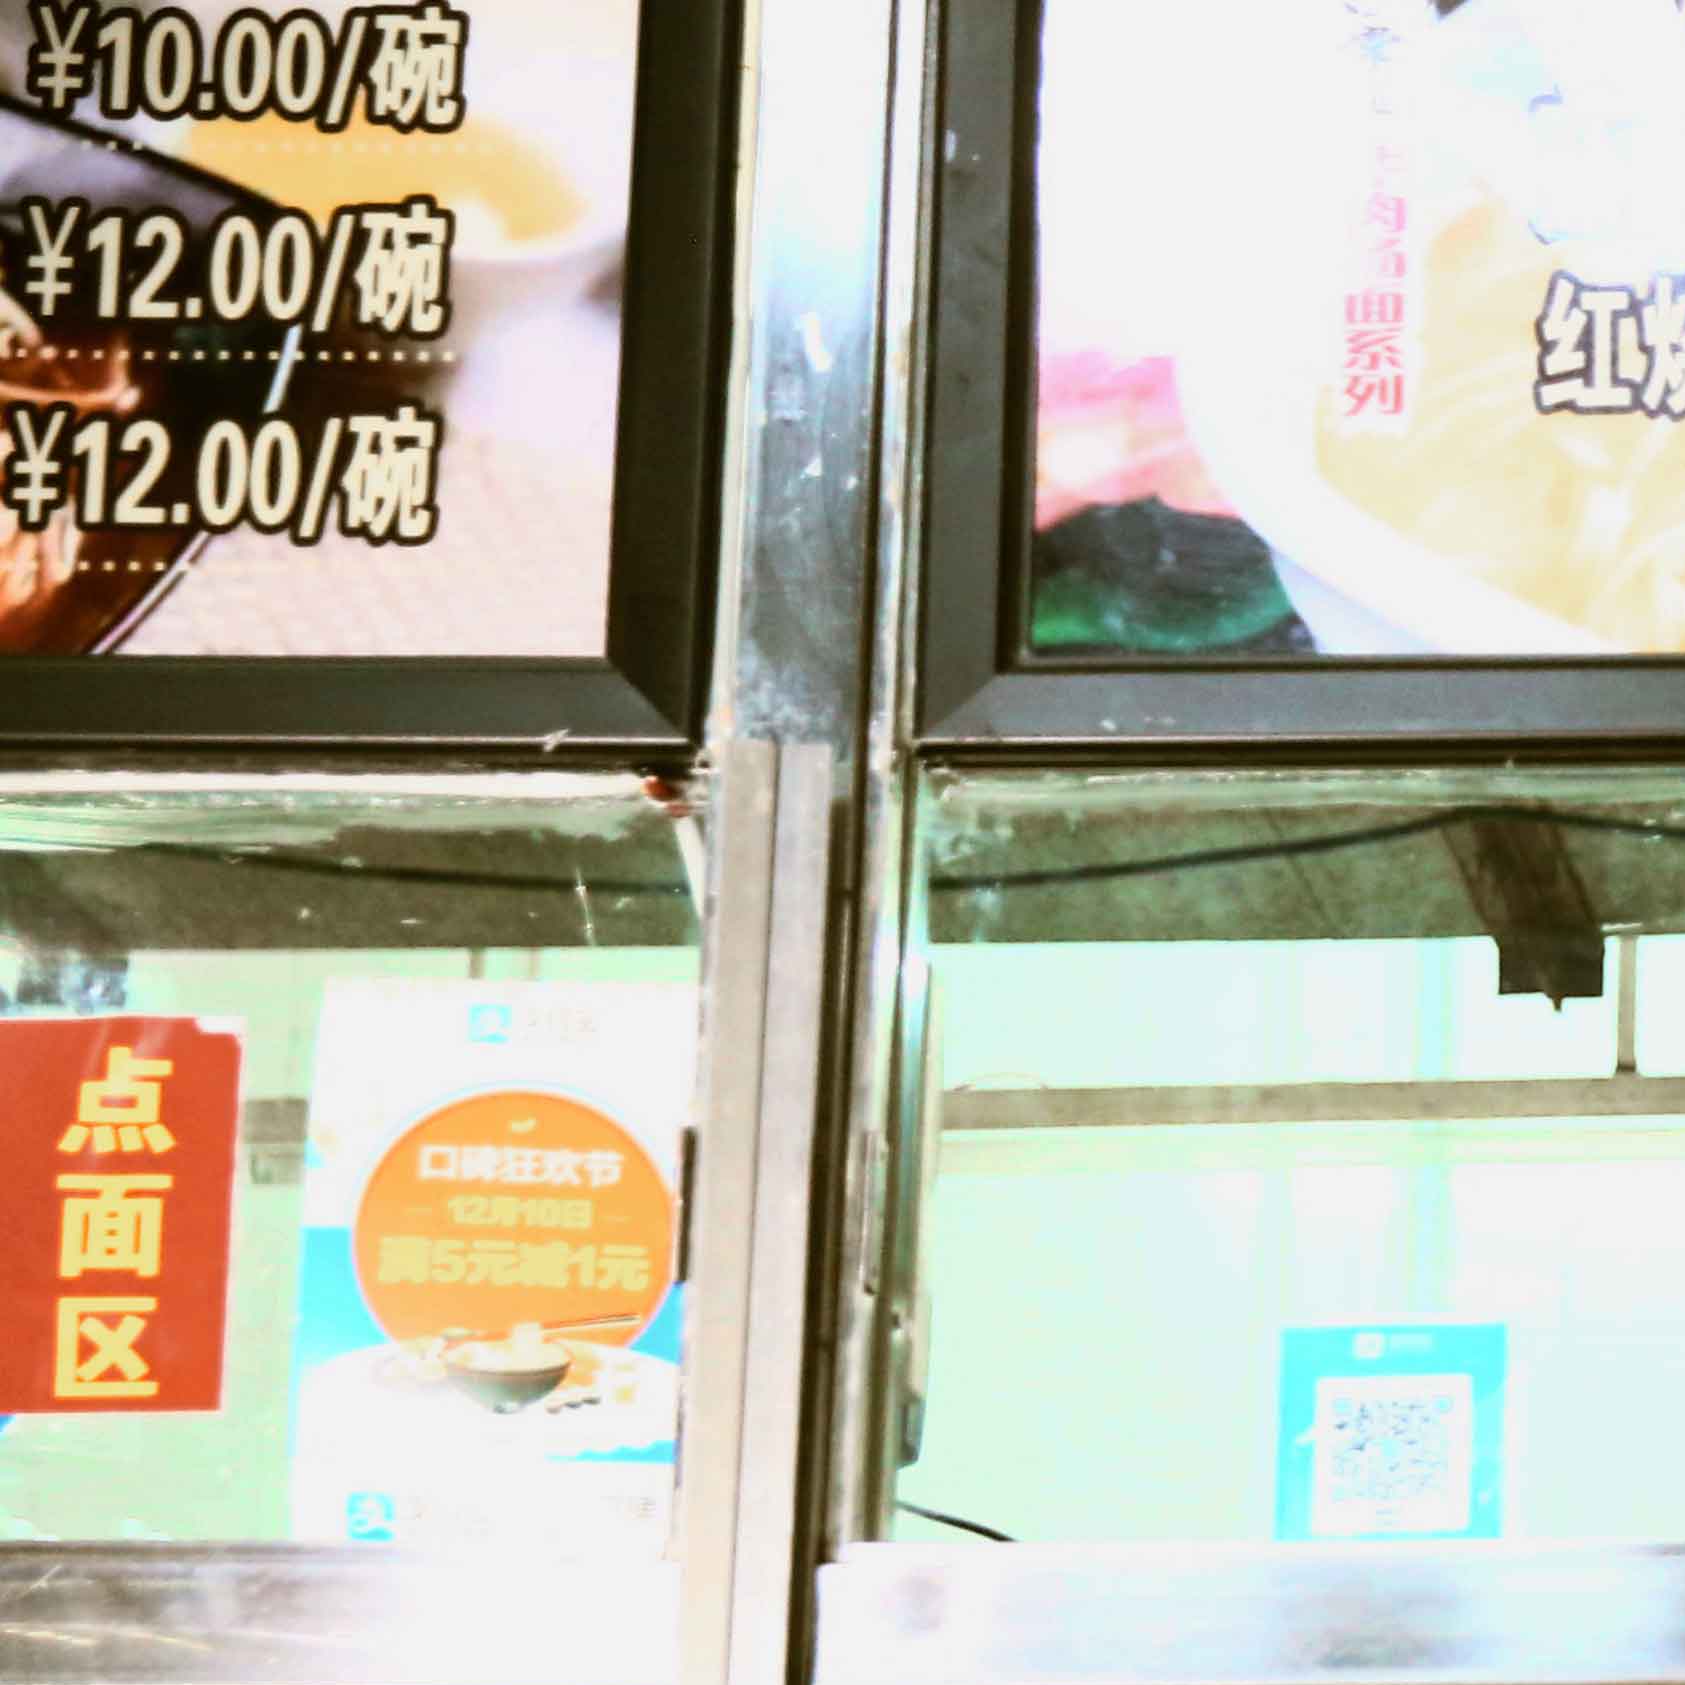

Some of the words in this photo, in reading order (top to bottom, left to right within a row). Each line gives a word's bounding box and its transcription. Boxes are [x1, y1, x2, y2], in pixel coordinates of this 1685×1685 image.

[36, 6, 462, 125] ¥10.00/碗
[25, 200, 450, 331] ¥12.00/碗
[12, 407, 436, 537] ¥12.00/碗
[57, 1046, 176, 1398] 点面区
